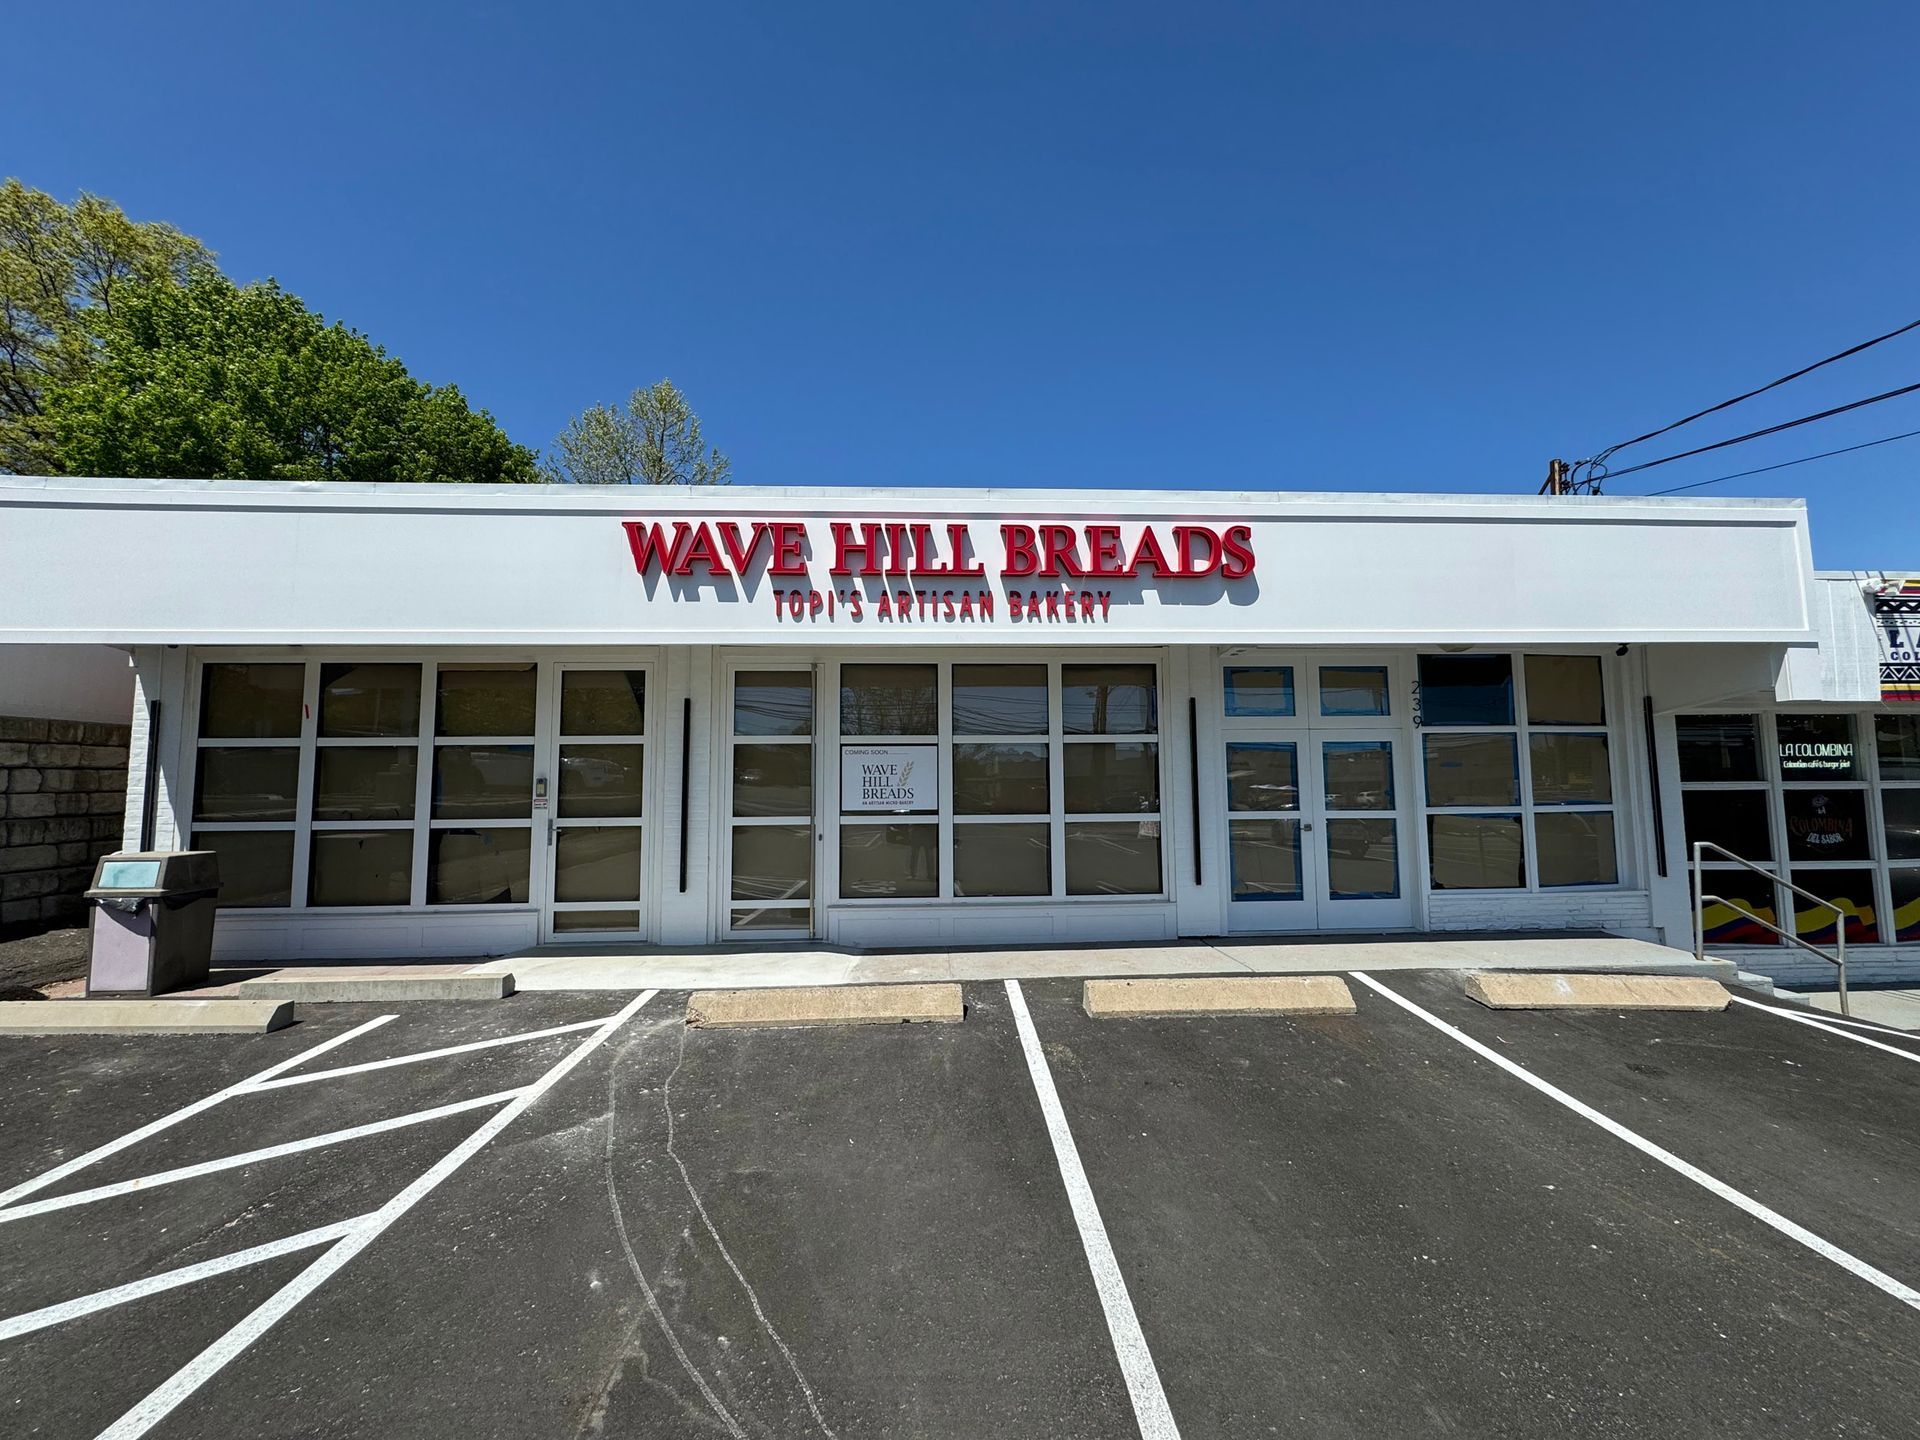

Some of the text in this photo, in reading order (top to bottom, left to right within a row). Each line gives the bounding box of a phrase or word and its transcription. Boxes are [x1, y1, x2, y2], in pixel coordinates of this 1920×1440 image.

[621, 522, 1256, 580] WAVE HILL BREADS
[773, 589, 1113, 623] TOPI'S ARTISAN BAKERY
[1411, 681, 1422, 729] 239
[1779, 743, 1853, 757] LA COLOMBINA
[862, 764, 898, 775] WAVE
[862, 776, 893, 787] HILL
[862, 788, 914, 799] BREADS
